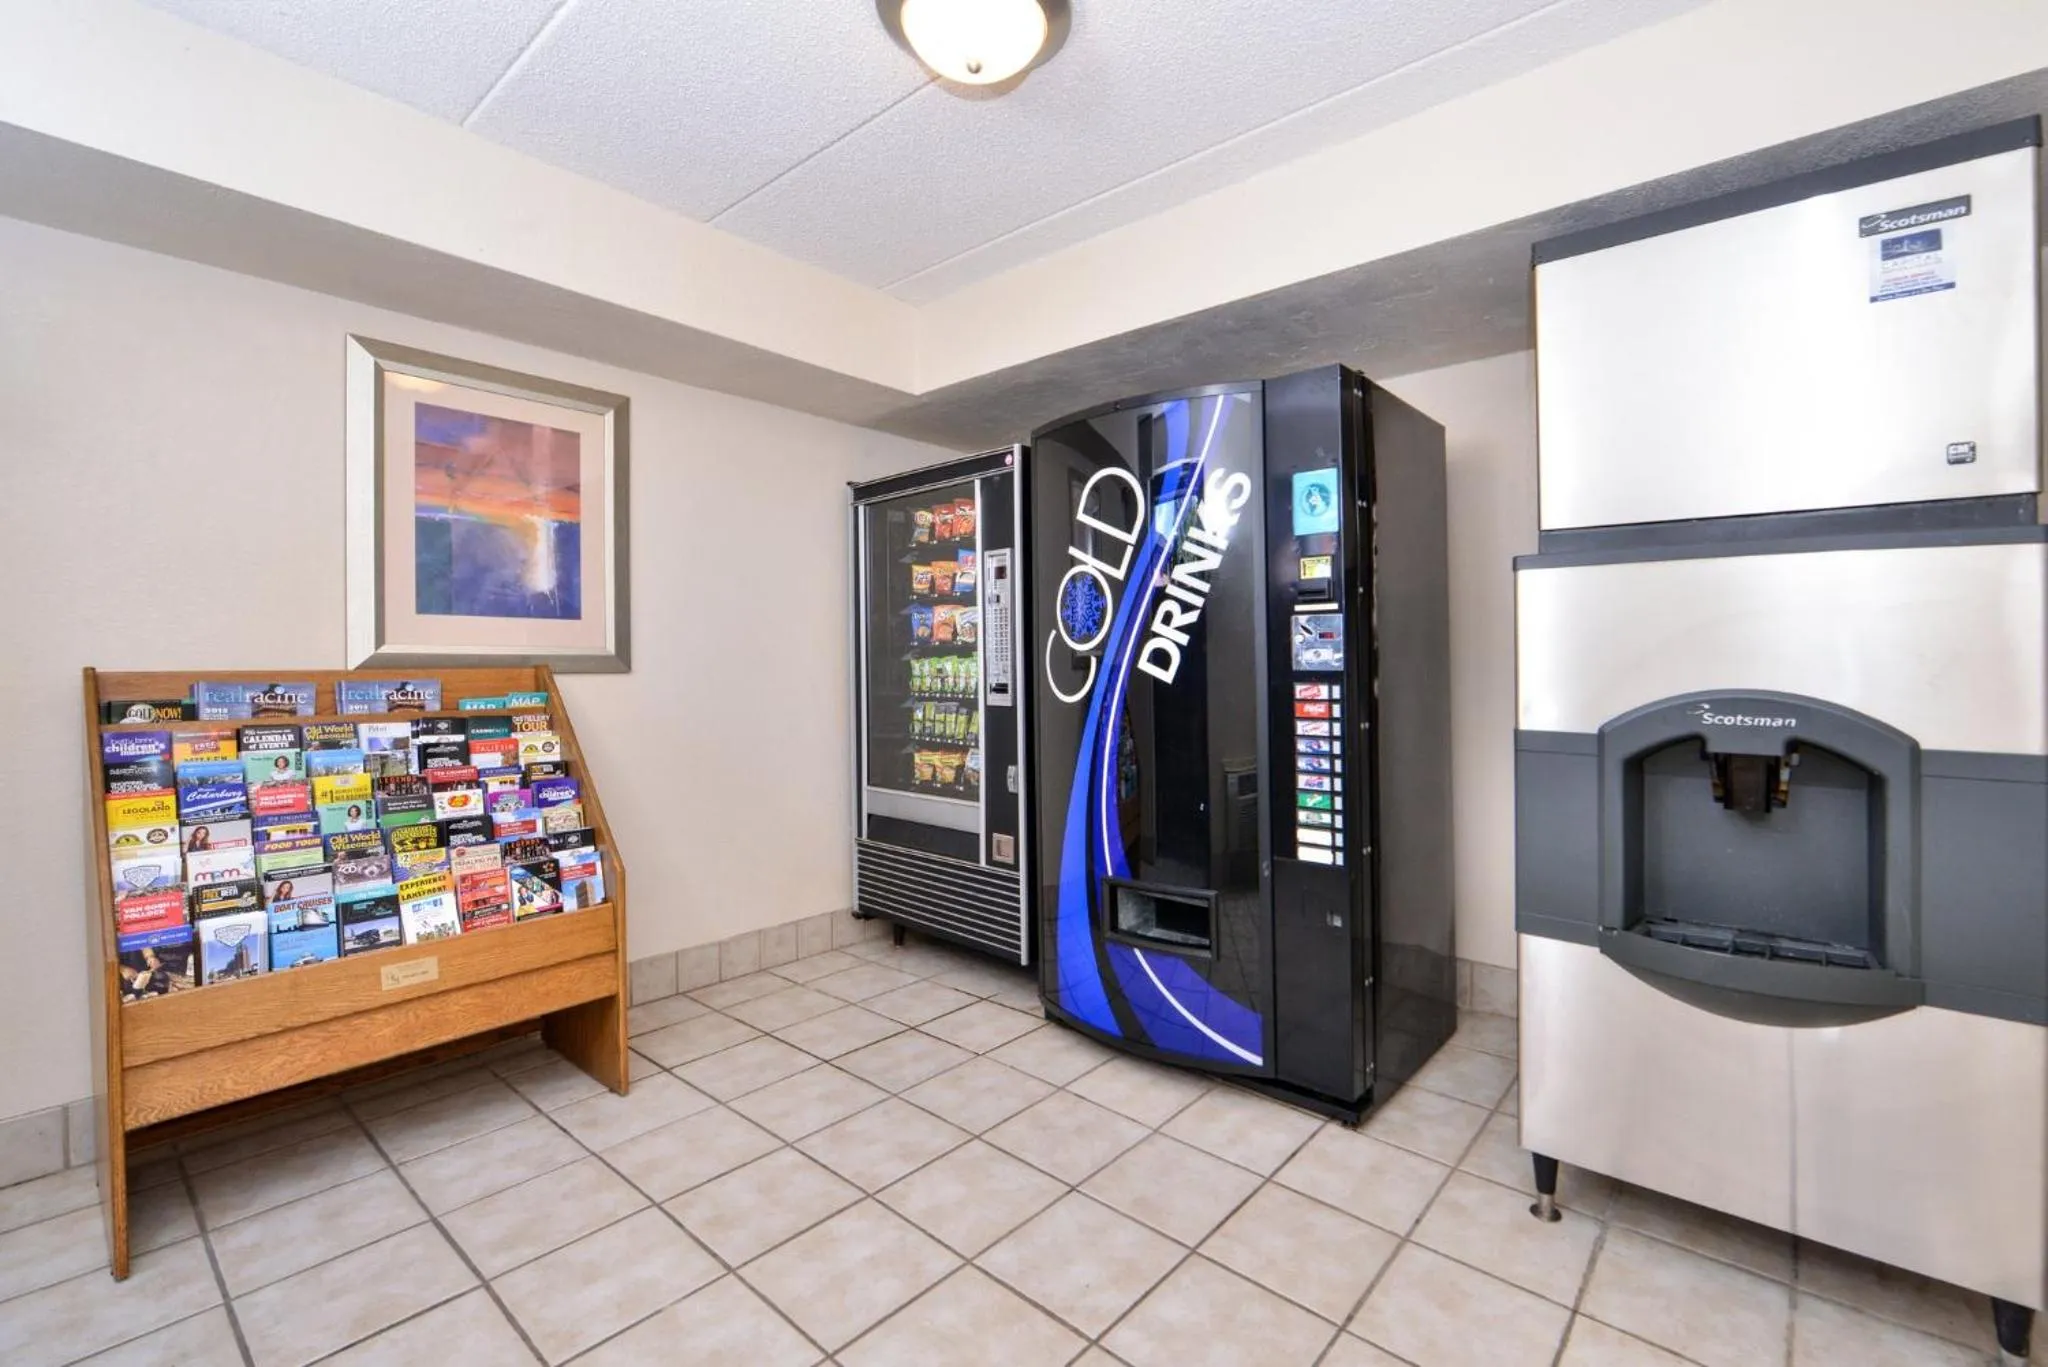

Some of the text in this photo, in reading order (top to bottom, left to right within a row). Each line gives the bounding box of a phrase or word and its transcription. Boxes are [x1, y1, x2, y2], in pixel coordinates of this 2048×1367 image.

[1879, 205, 1967, 231] Scotsman
[1137, 467, 1251, 685] DRINKS
[1046, 467, 1145, 703] COLD
[516, 721, 548, 732] TOUR
[1701, 712, 1797, 727] Scotsman
[323, 724, 353, 734] World
[243, 732, 295, 743] CALENDAR
[259, 740, 289, 749] EVENTS
[105, 741, 166, 753] children's
[122, 804, 171, 815] LEGOLAND
[264, 838, 321, 851] FOOD TOUR
[330, 833, 348, 846] Old
[349, 829, 381, 842] World
[400, 875, 446, 891] EXPERIENCE
[401, 886, 447, 901] LAKEFRONT
[274, 896, 332, 913] BOAT CRUISES
